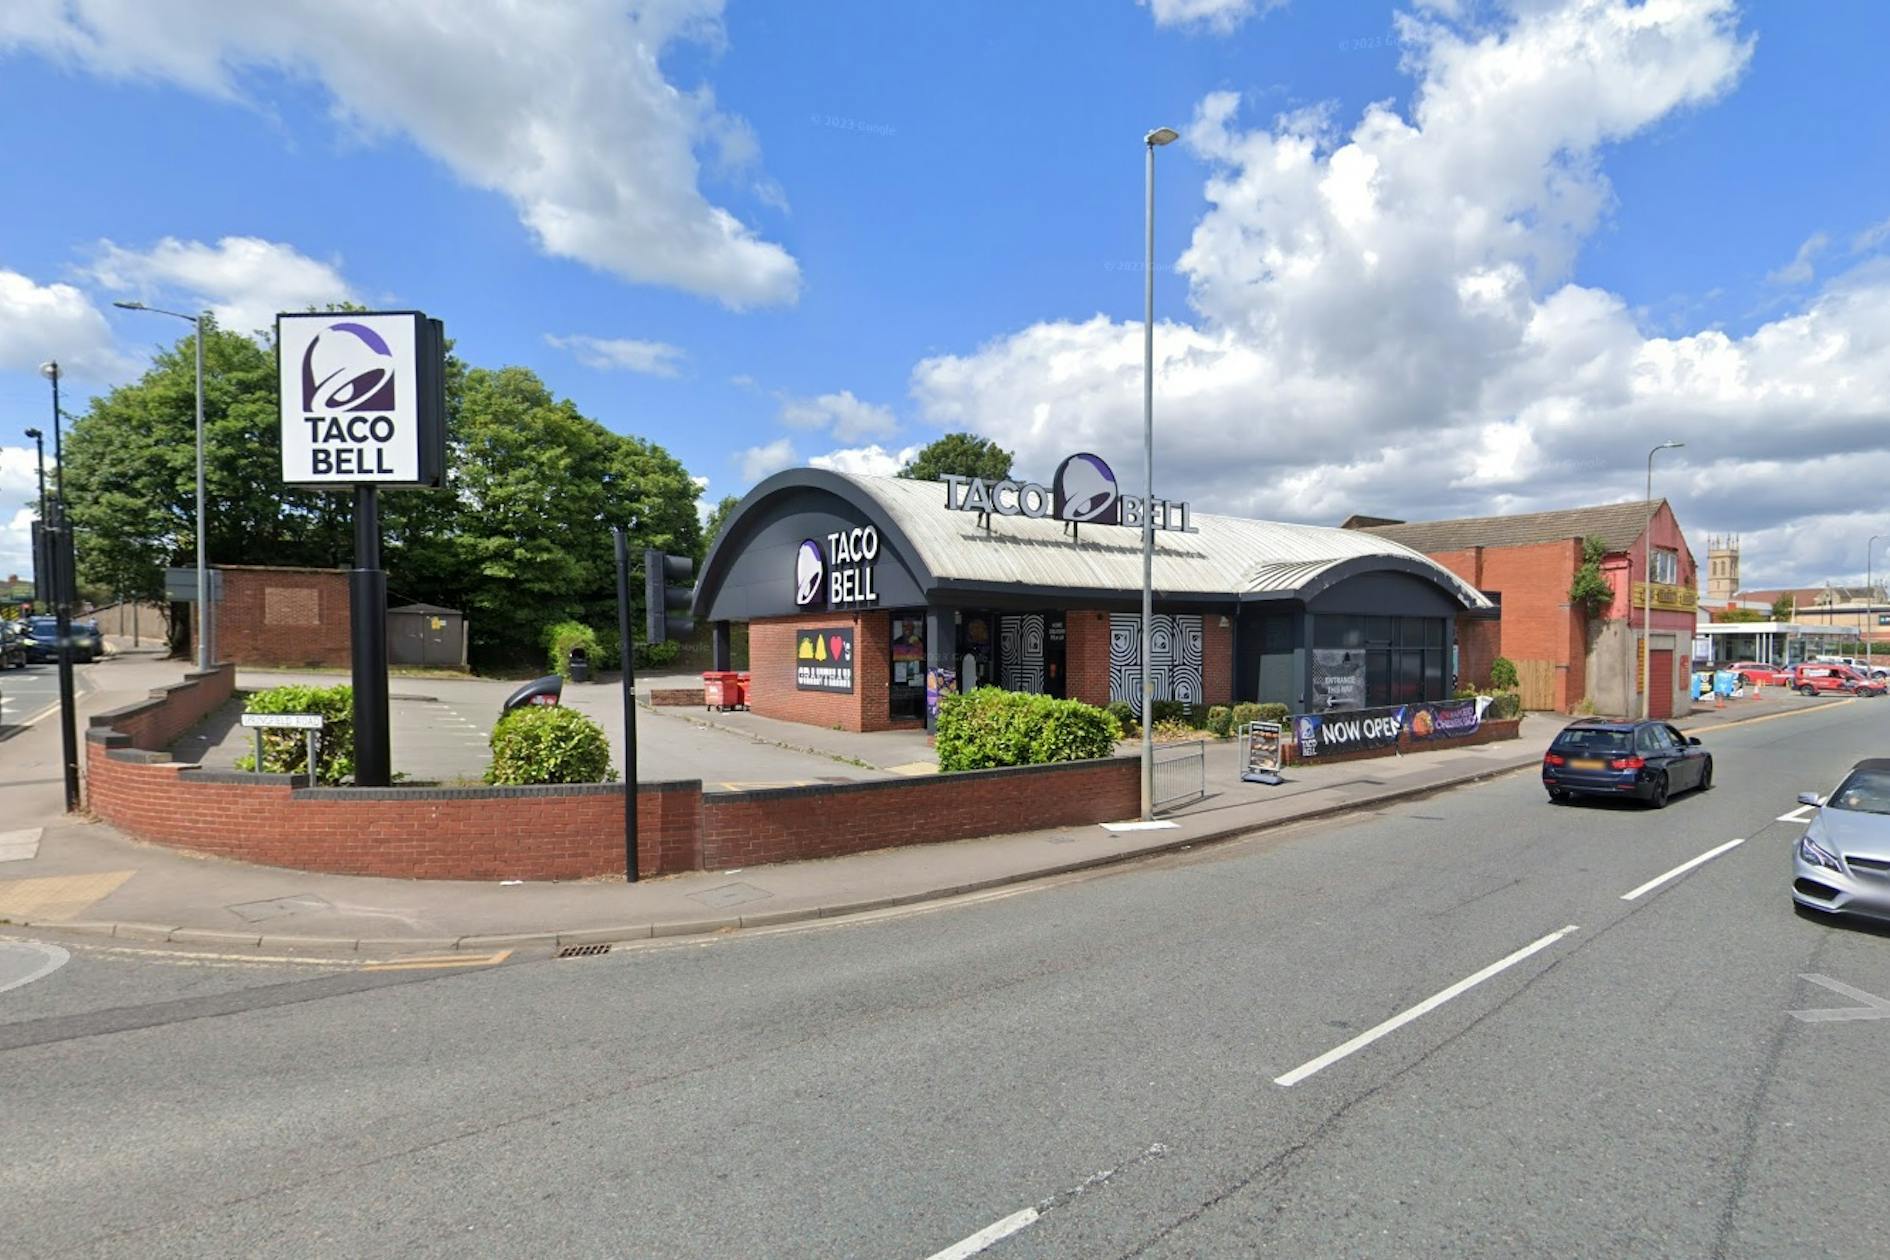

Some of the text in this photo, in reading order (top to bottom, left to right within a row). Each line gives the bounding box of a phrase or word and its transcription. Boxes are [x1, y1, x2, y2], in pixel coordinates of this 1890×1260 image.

[304, 415, 395, 443] TACO
[312, 447, 394, 474] BELL
[940, 473, 1199, 534] TACO BELL
[827, 525, 878, 565] TACO
[831, 566, 877, 603] BELL
[1301, 739, 1318, 748] TACO
[1321, 717, 1400, 745] NOW OPEN
